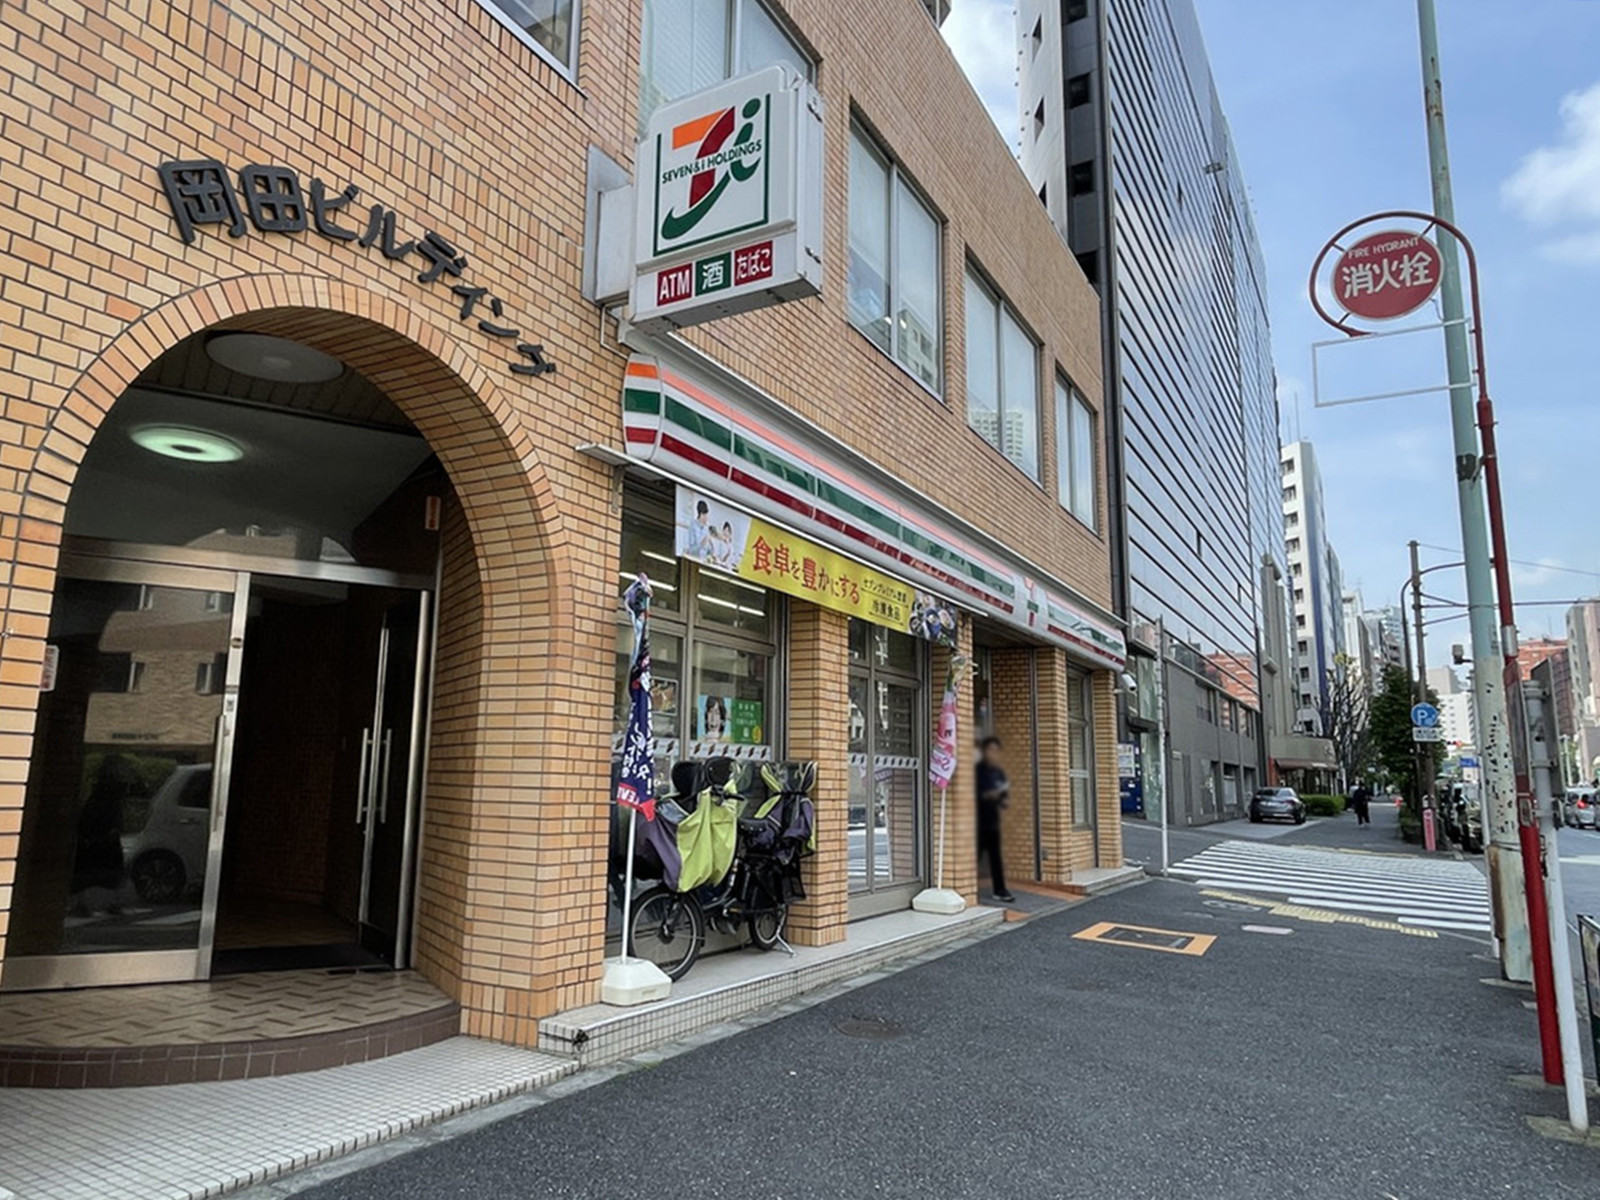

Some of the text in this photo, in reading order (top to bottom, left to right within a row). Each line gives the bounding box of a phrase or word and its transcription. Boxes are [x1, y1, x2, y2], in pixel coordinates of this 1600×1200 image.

[707, 139, 762, 167] HOLDINGS
[1348, 237, 1419, 259] FIRE HYDRANT
[158, 159, 556, 376] 岡田ビルディング
[702, 260, 724, 290] 酒
[737, 249, 772, 279] たばこ
[1342, 251, 1433, 299] 消火栓
[660, 269, 690, 300] ATM
[752, 535, 860, 605] 食卓を豊かにする
[1417, 709, 1428, 726] P
